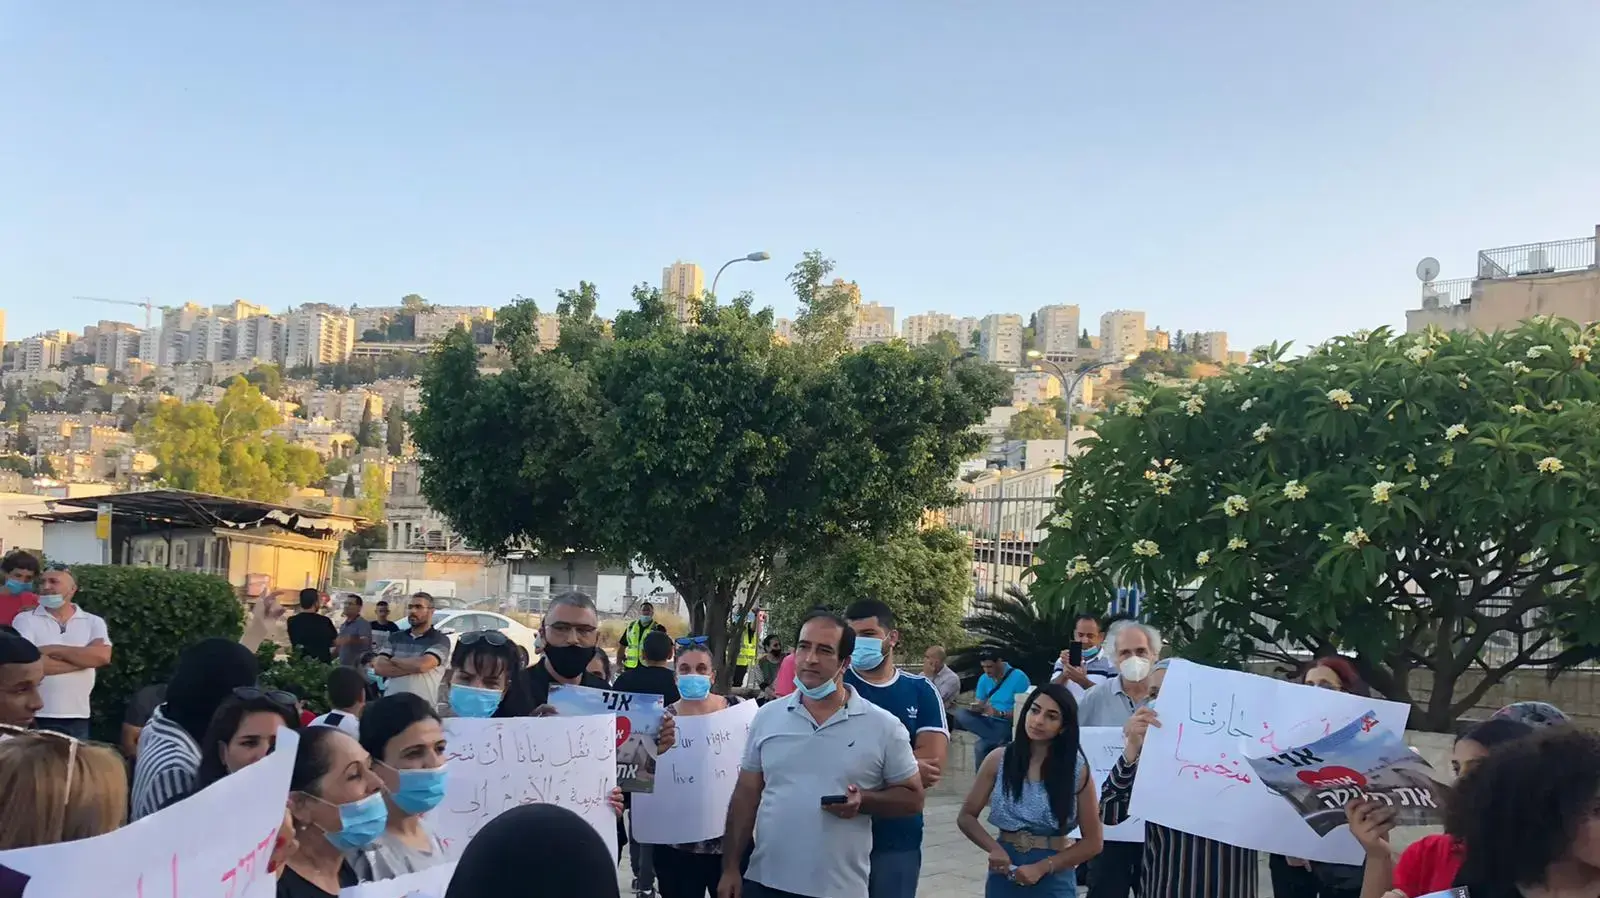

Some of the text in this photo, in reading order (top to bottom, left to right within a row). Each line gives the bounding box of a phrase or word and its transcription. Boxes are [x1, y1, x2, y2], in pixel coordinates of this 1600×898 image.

[602, 691, 633, 711] אני
[705, 729, 731, 755] right
[1267, 747, 1324, 768] אני
[672, 763, 694, 785] live
[1391, 787, 1437, 809] את
